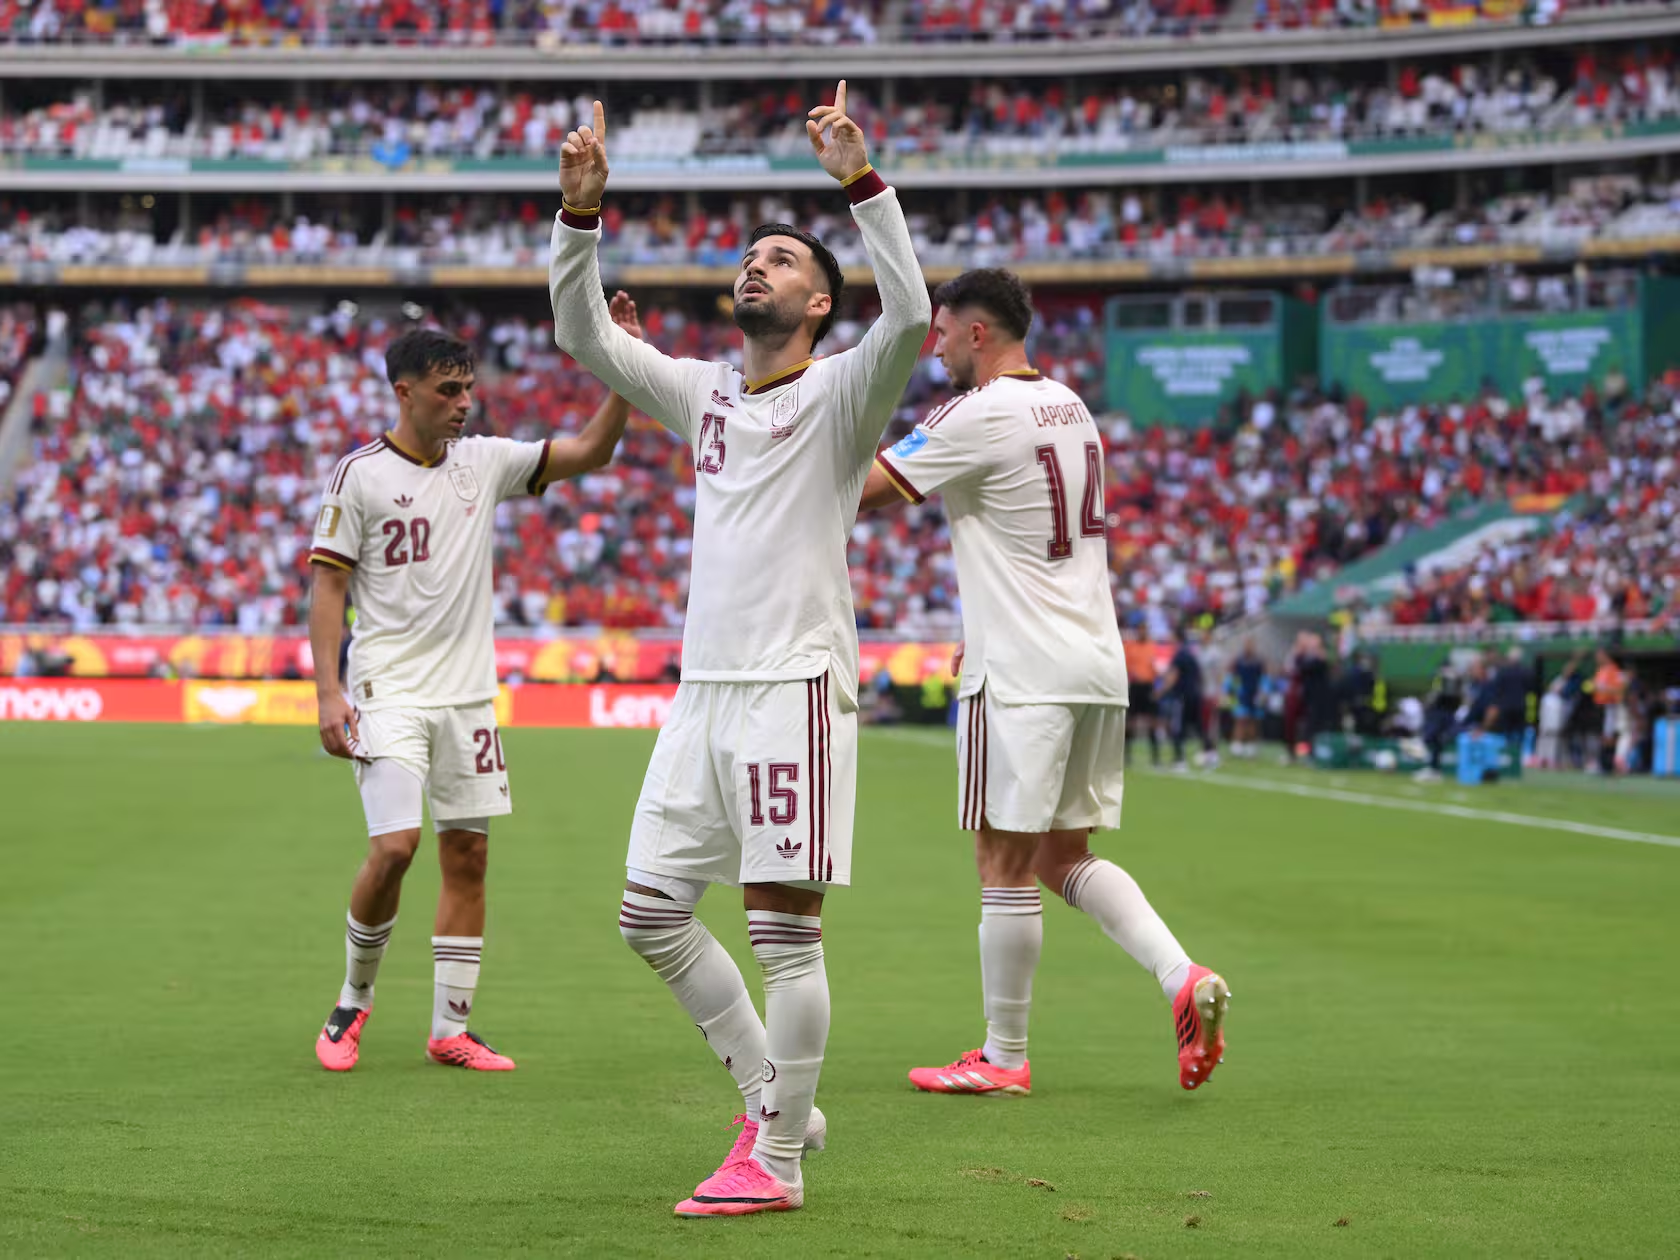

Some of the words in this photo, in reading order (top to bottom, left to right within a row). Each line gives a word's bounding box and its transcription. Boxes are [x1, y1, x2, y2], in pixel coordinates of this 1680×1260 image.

[1035, 441, 1105, 560] 14
[383, 516, 430, 567] 20
[747, 763, 799, 826] 15
